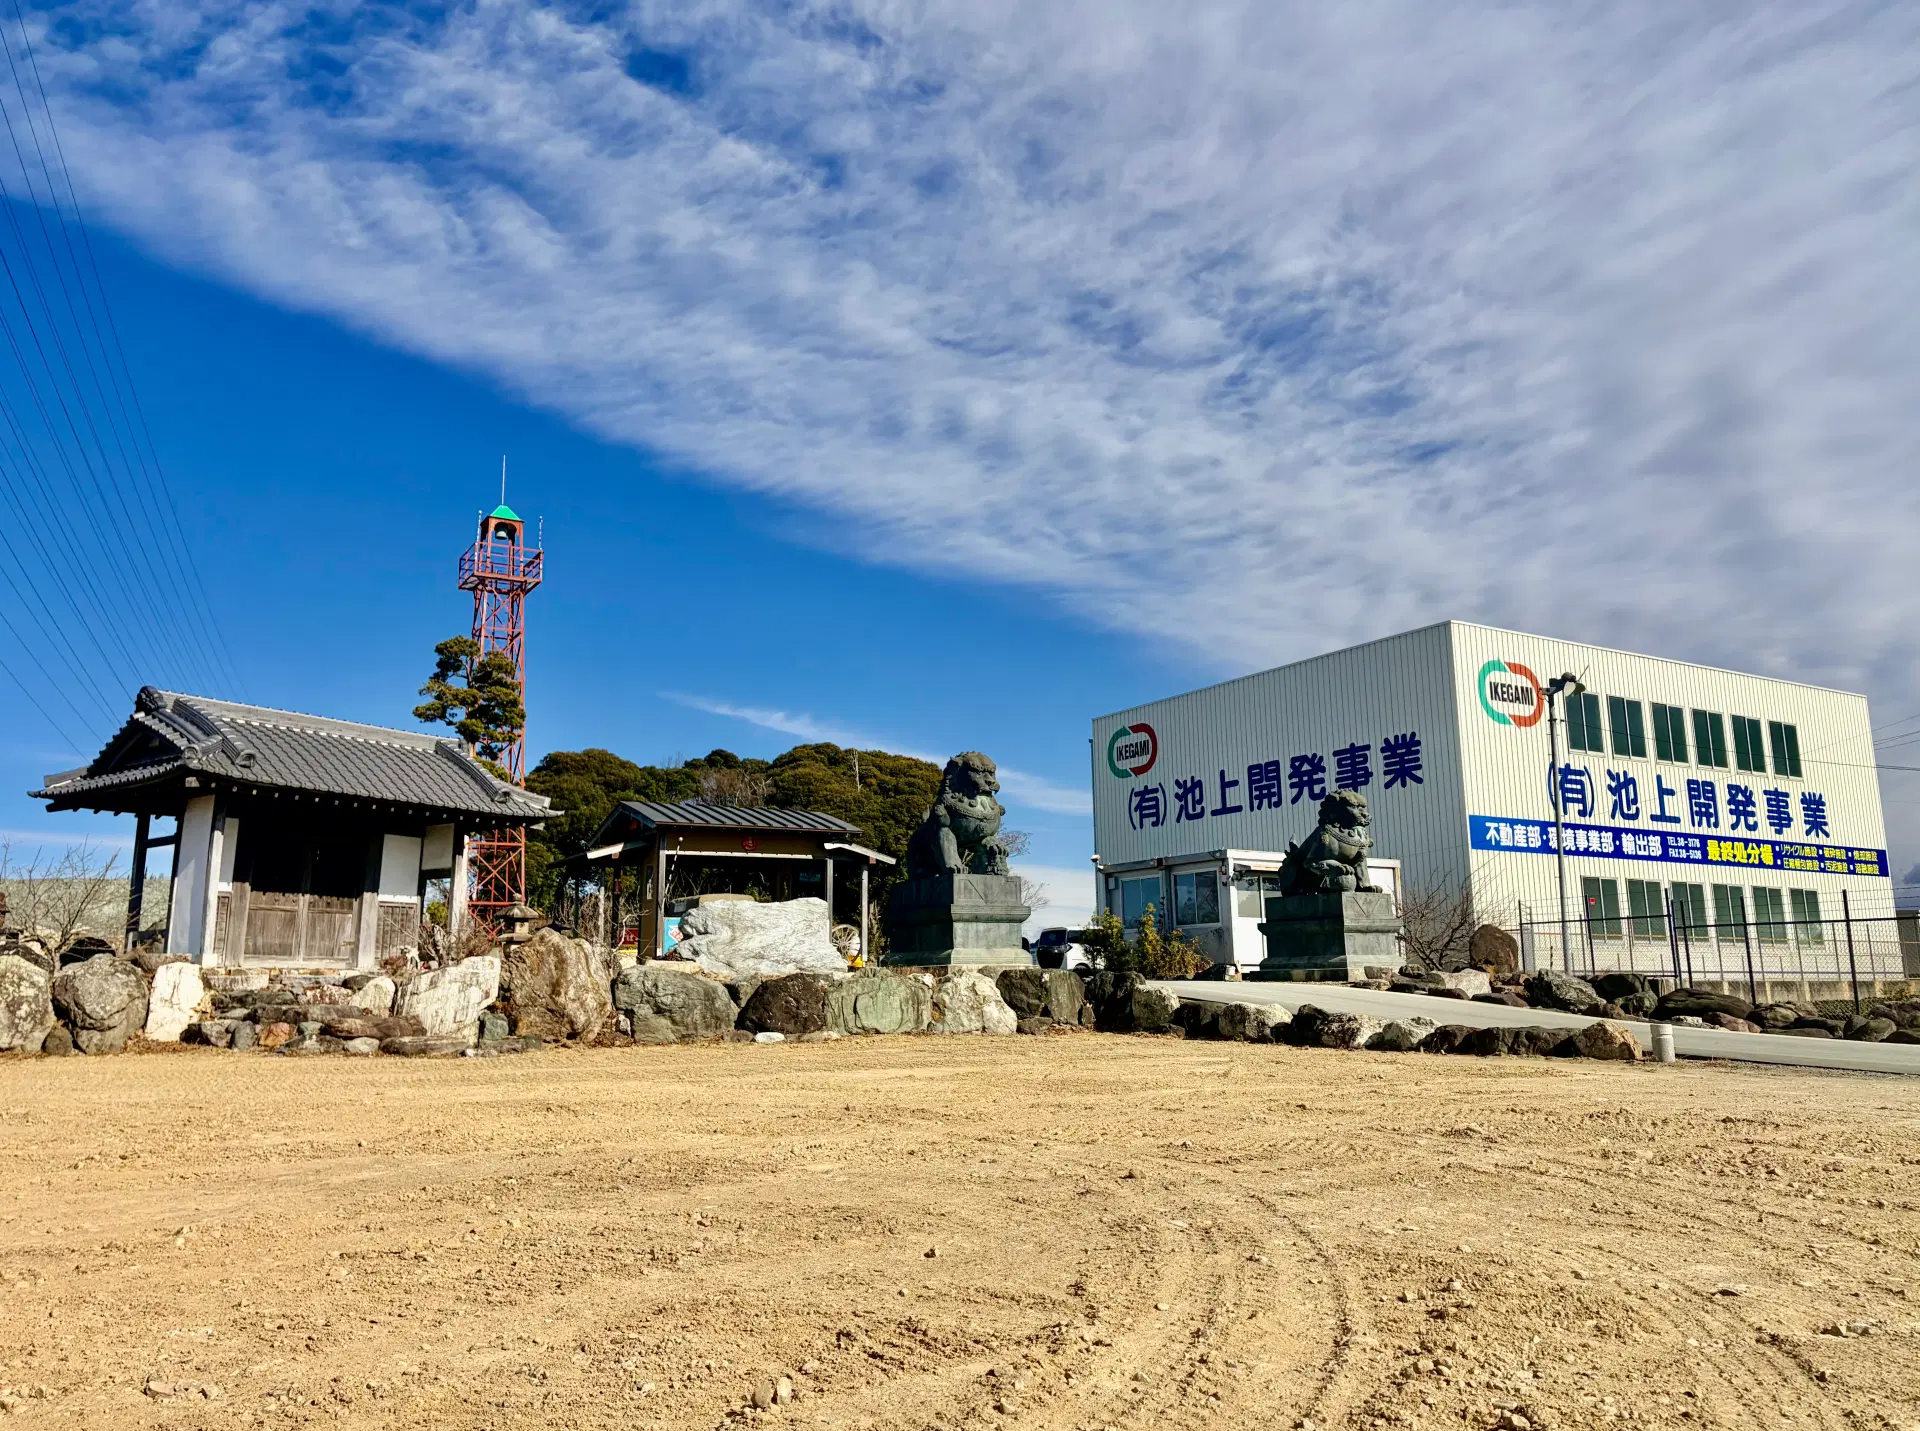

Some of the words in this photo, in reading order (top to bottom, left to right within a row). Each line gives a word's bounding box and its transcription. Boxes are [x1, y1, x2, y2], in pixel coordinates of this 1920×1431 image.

[1489, 681, 1534, 707] IKEGAMI
[1115, 740, 1150, 762] IKEGAMI
[1706, 839, 1774, 865] 最終処分場
